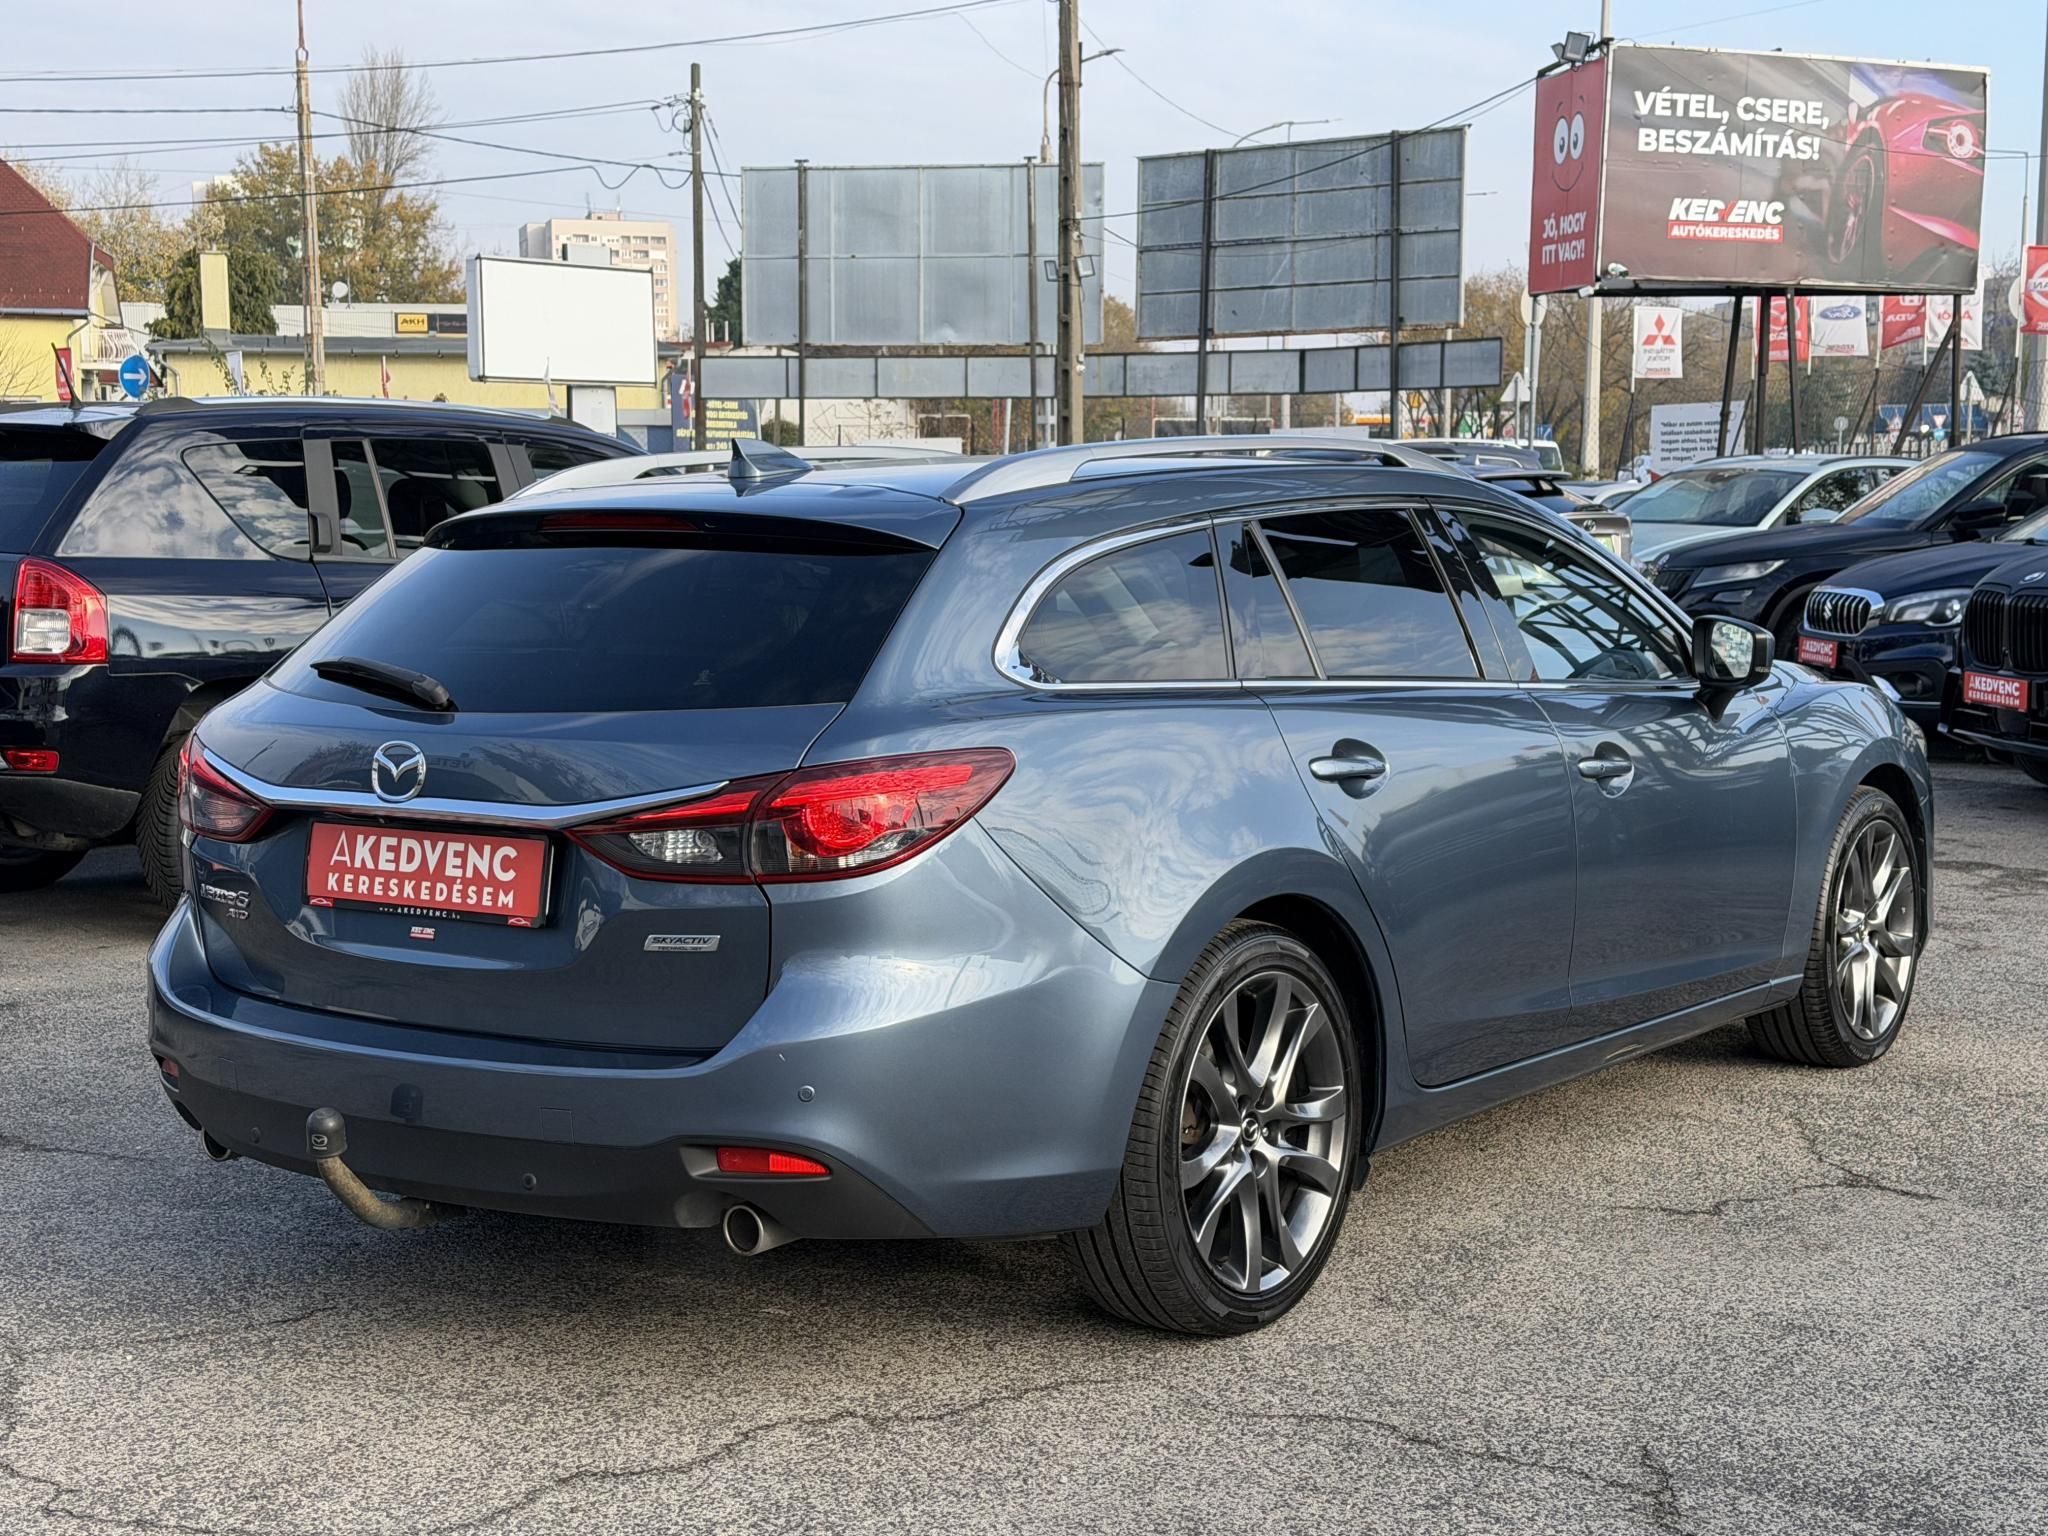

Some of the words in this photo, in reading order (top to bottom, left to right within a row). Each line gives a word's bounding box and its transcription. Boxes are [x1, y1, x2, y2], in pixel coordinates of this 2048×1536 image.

[1633, 86, 1730, 124] VÉTEL,
[1736, 96, 1830, 130] CSERE,
[1637, 126, 1822, 161] BESZÁMÍTÁS!
[1668, 197, 1785, 224] KEDVENC
[1542, 212, 1558, 241] JÓ,
[1559, 211, 1587, 237] HOGY
[1671, 224, 1780, 240] AUTÓKERESKEDÉS
[1541, 244, 1557, 265] ITT
[1558, 239, 1585, 263] VAGY!
[400, 318, 425, 326] AKH
[327, 872, 514, 908] KERESKEDÉSEM
[651, 936, 712, 944] SKYACTIV
